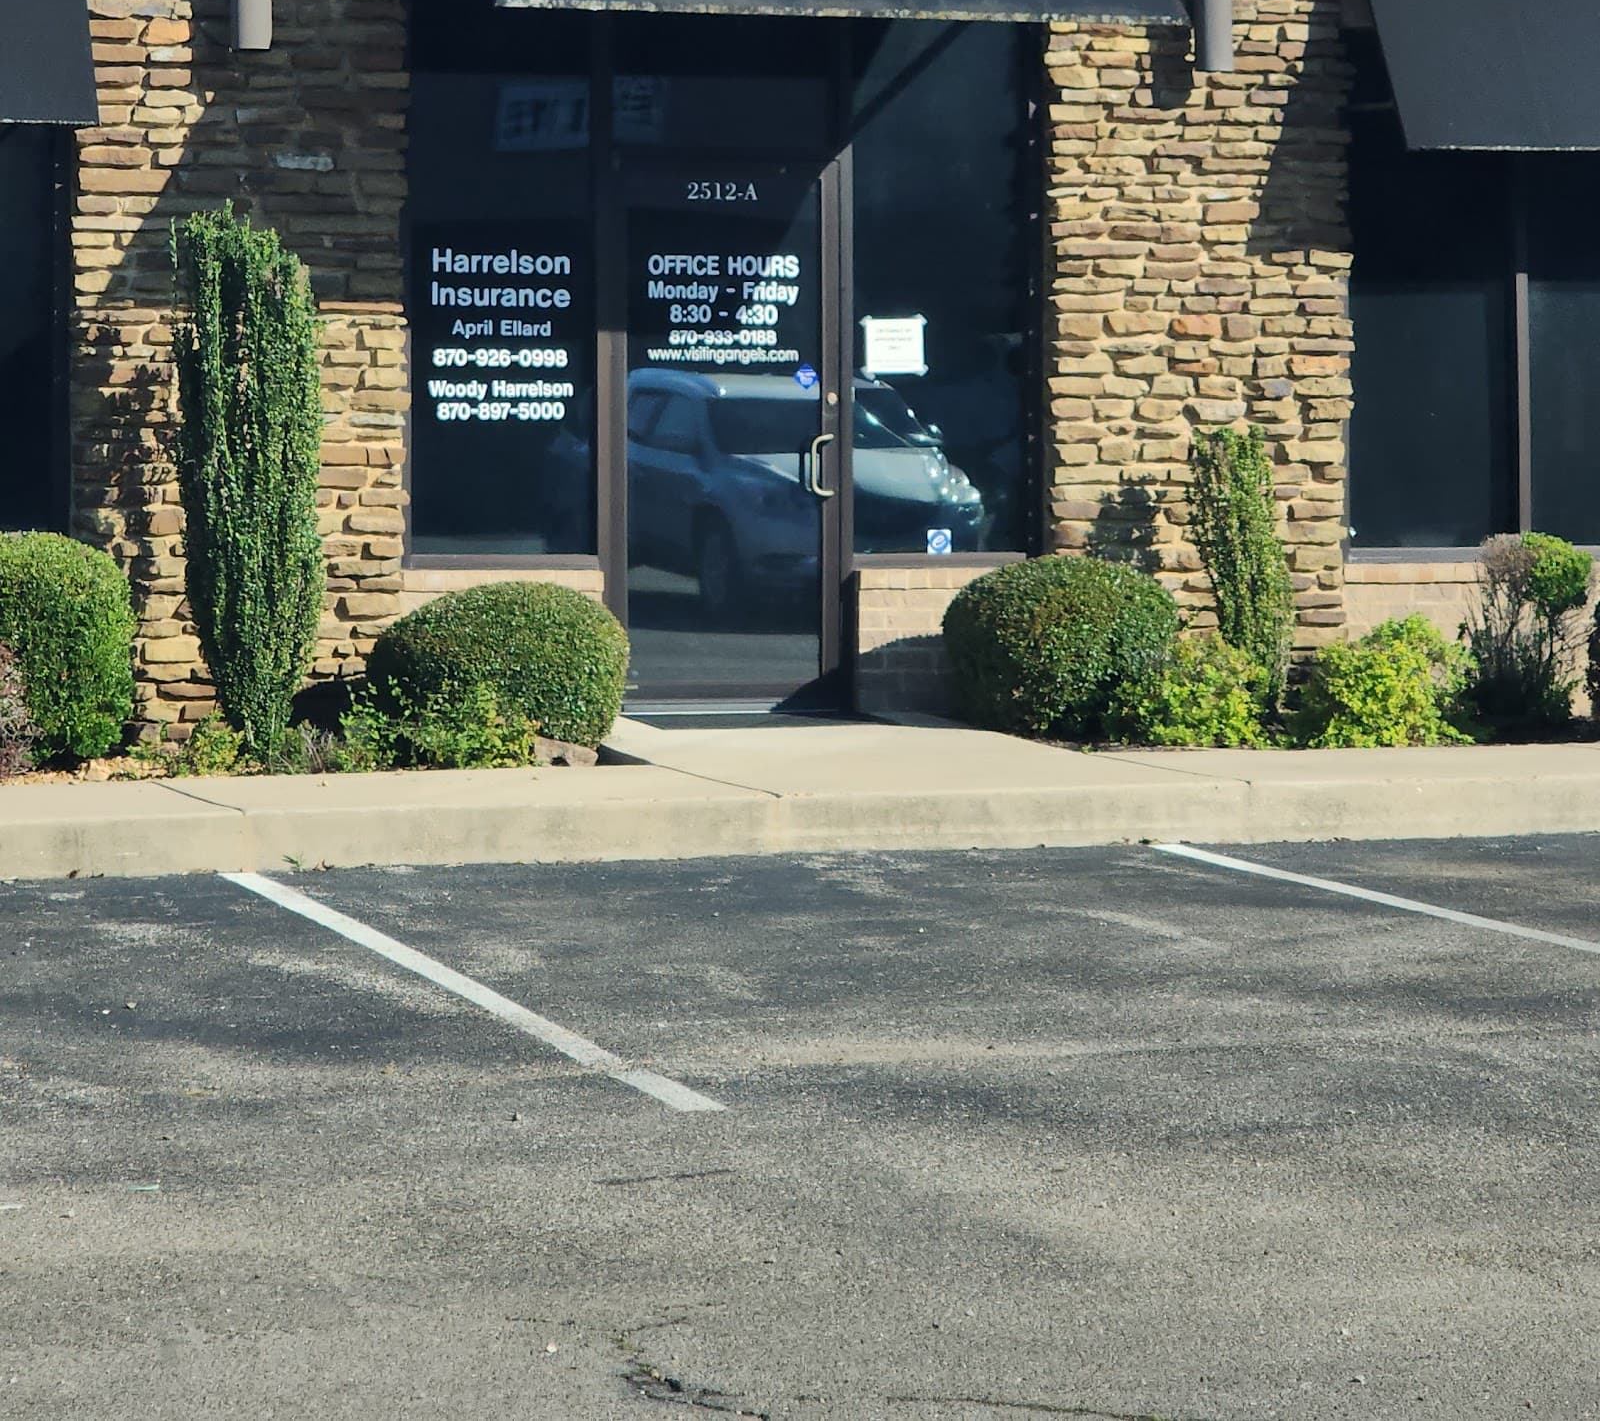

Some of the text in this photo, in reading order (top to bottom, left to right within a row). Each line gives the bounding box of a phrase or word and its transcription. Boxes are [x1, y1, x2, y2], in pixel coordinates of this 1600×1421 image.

[687, 182, 758, 200] 2512-A
[432, 248, 571, 274] Harrelson
[648, 255, 800, 278] OFFICE HOURS
[431, 281, 571, 308] Insurance
[648, 281, 718, 302] Monday
[743, 282, 799, 305] Friday
[669, 305, 712, 323] 8:30
[735, 305, 778, 325] 4:30
[452, 319, 552, 339] April Ellard
[432, 348, 568, 367] 870-926-0998
[647, 346, 799, 365] www.visitingangels.com
[428, 380, 574, 400] Woody Harrelson
[436, 402, 565, 420] 870-897-5000
